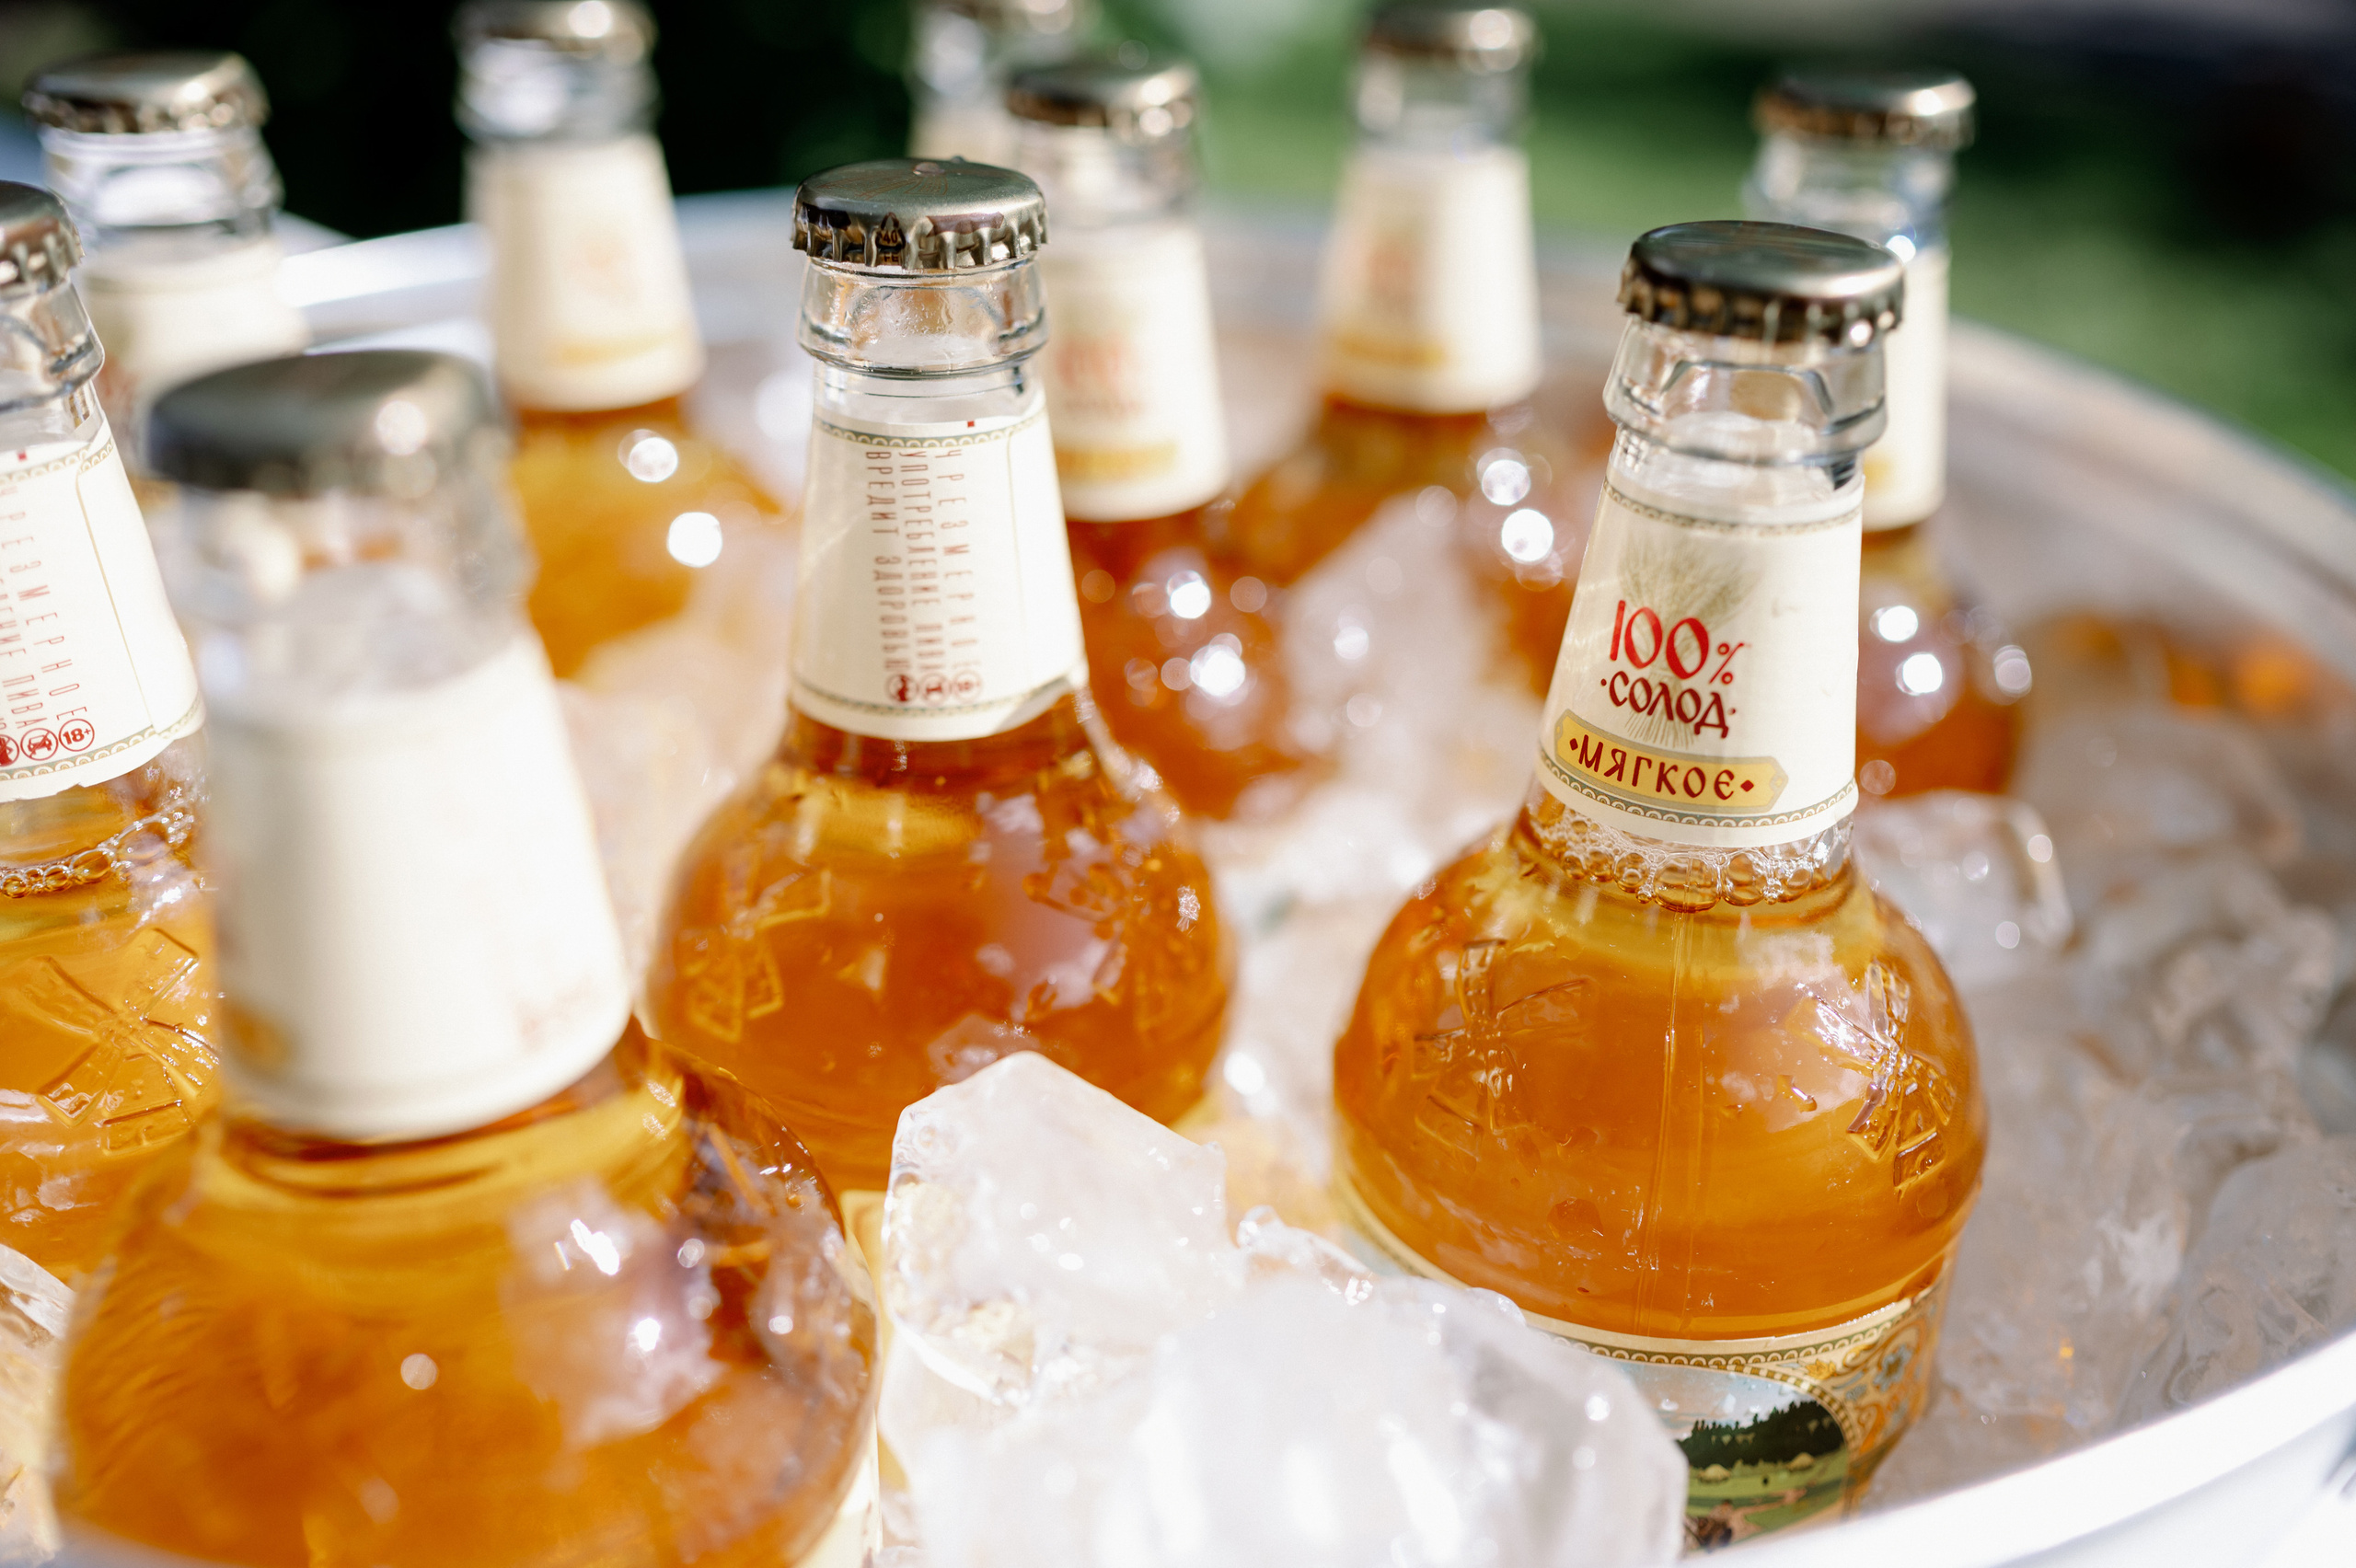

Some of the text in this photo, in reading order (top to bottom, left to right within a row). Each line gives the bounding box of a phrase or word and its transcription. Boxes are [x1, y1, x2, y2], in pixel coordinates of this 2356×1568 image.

[865, 451, 899, 536] ВРЕДИТ
[1609, 599, 1751, 685] 100%
[2, 674, 48, 729] ПИВА
[63, 727, 91, 745] 18+
[1608, 670, 1729, 739] СОЛОД
